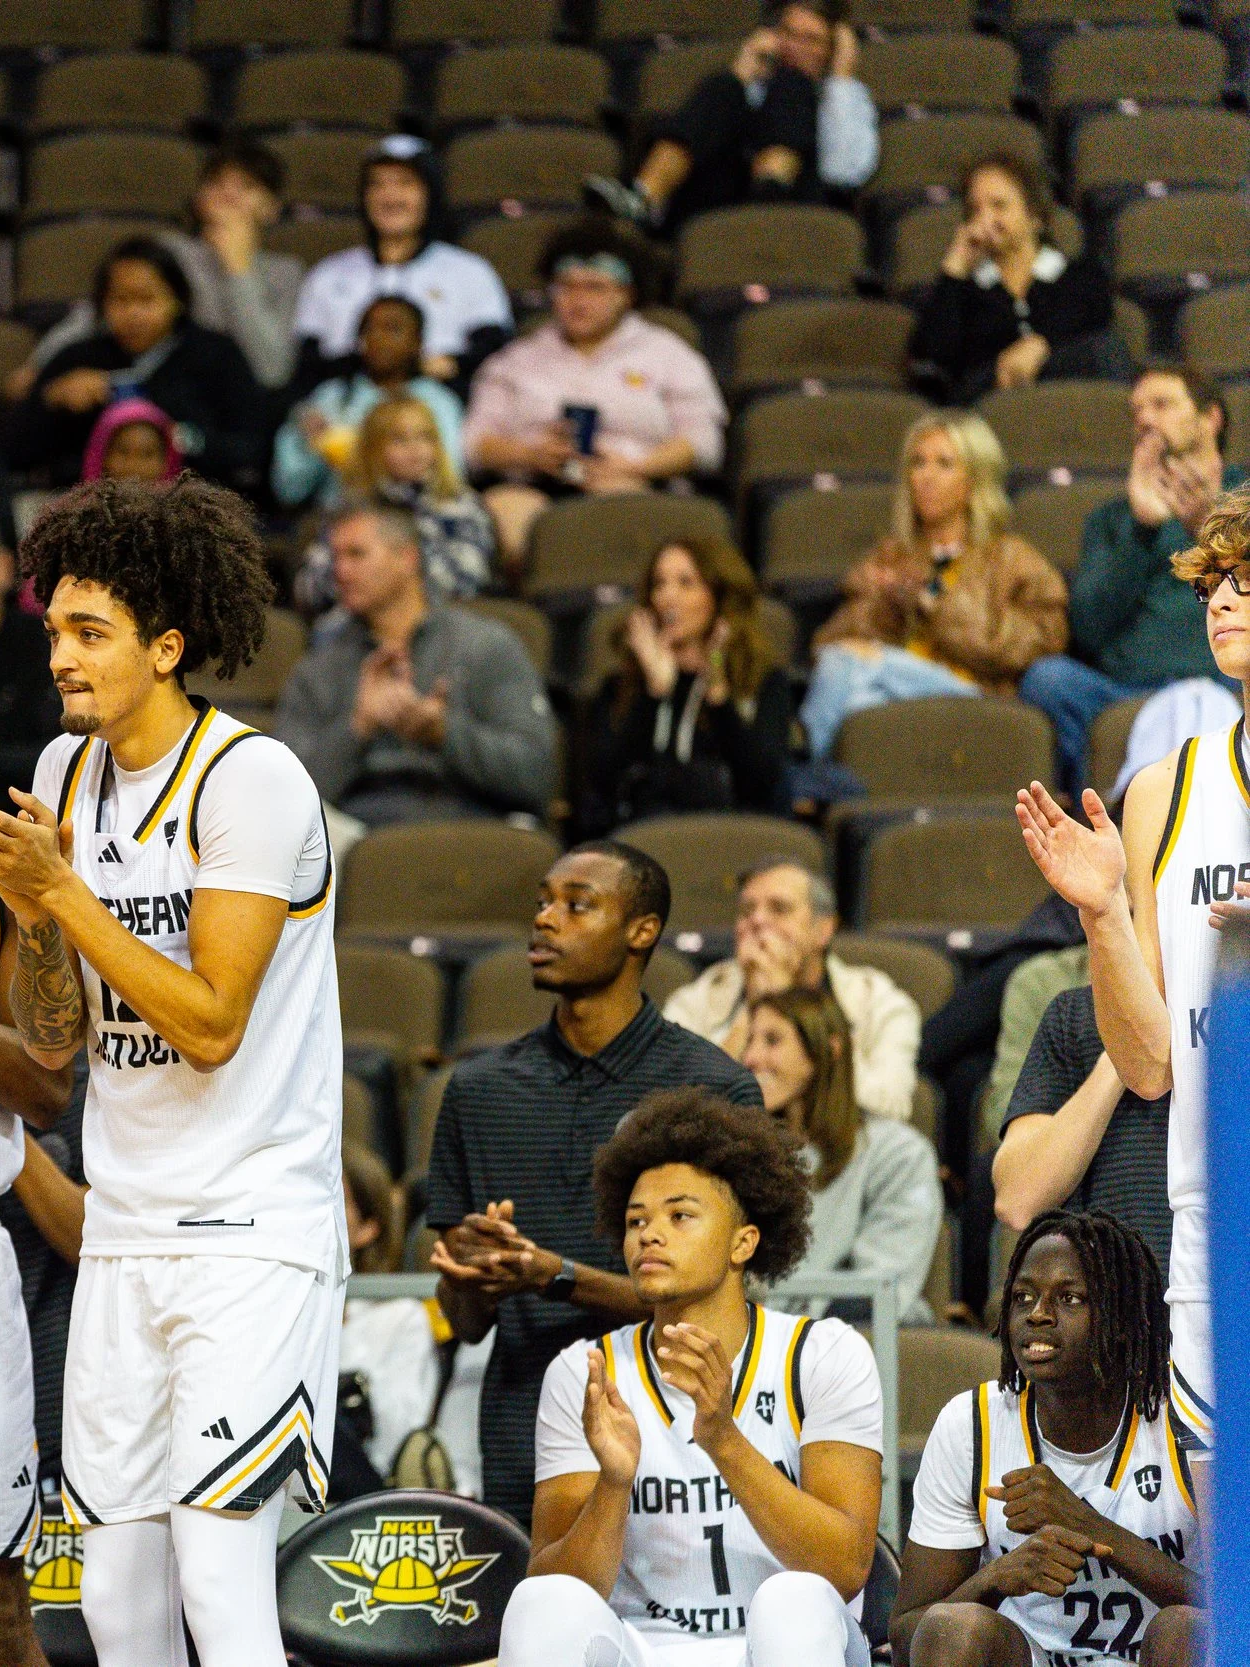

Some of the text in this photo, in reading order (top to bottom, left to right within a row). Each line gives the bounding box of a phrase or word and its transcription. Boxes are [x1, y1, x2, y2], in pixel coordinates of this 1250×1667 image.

[382, 1521, 434, 1535] NKU
[703, 1523, 731, 1596] 1
[1063, 1591, 1144, 1656] 22
